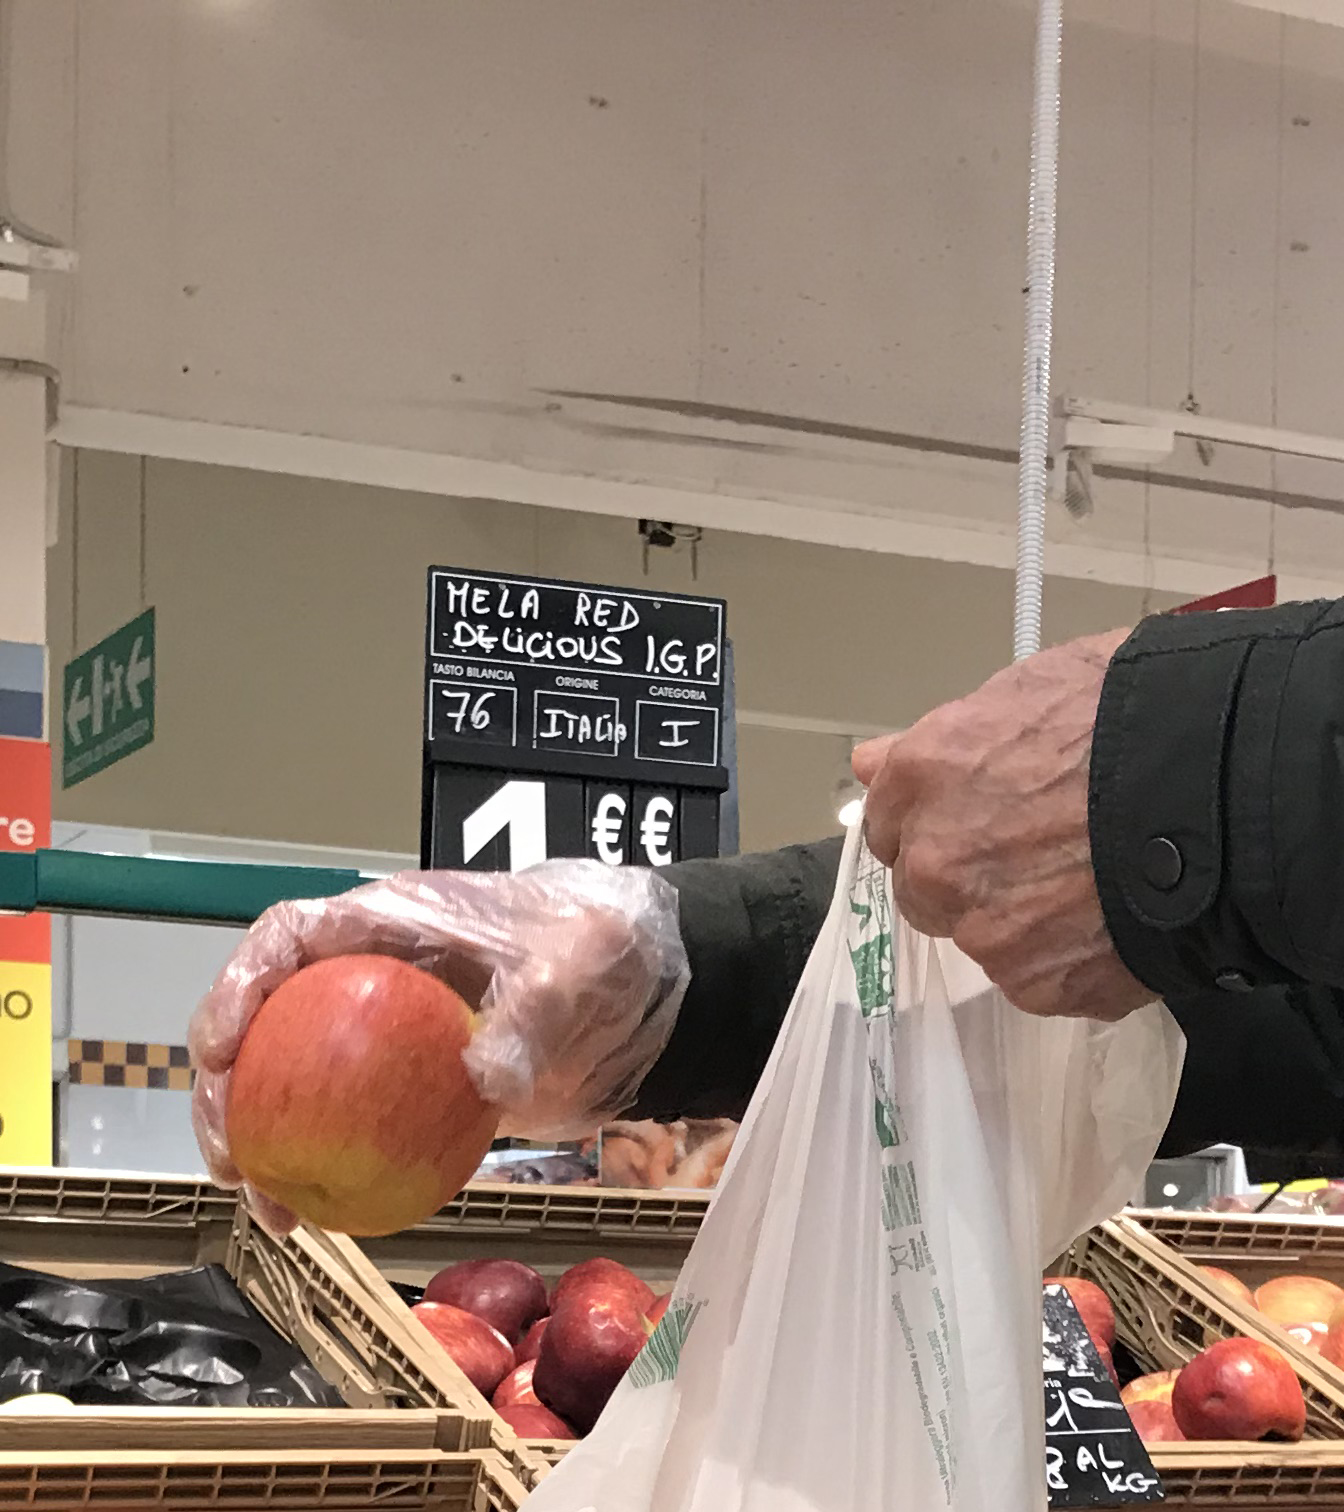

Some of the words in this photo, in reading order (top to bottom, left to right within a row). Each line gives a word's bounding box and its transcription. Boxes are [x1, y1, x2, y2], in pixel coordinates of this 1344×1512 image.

[446, 581, 540, 620] MELA
[574, 592, 640, 633] RED
[433, 664, 463, 677] TASTO
[466, 667, 515, 682] BILANCIA
[555, 676, 599, 690] ORIGINE
[649, 686, 706, 701] CATEGORIA
[442, 690, 496, 733] 76
